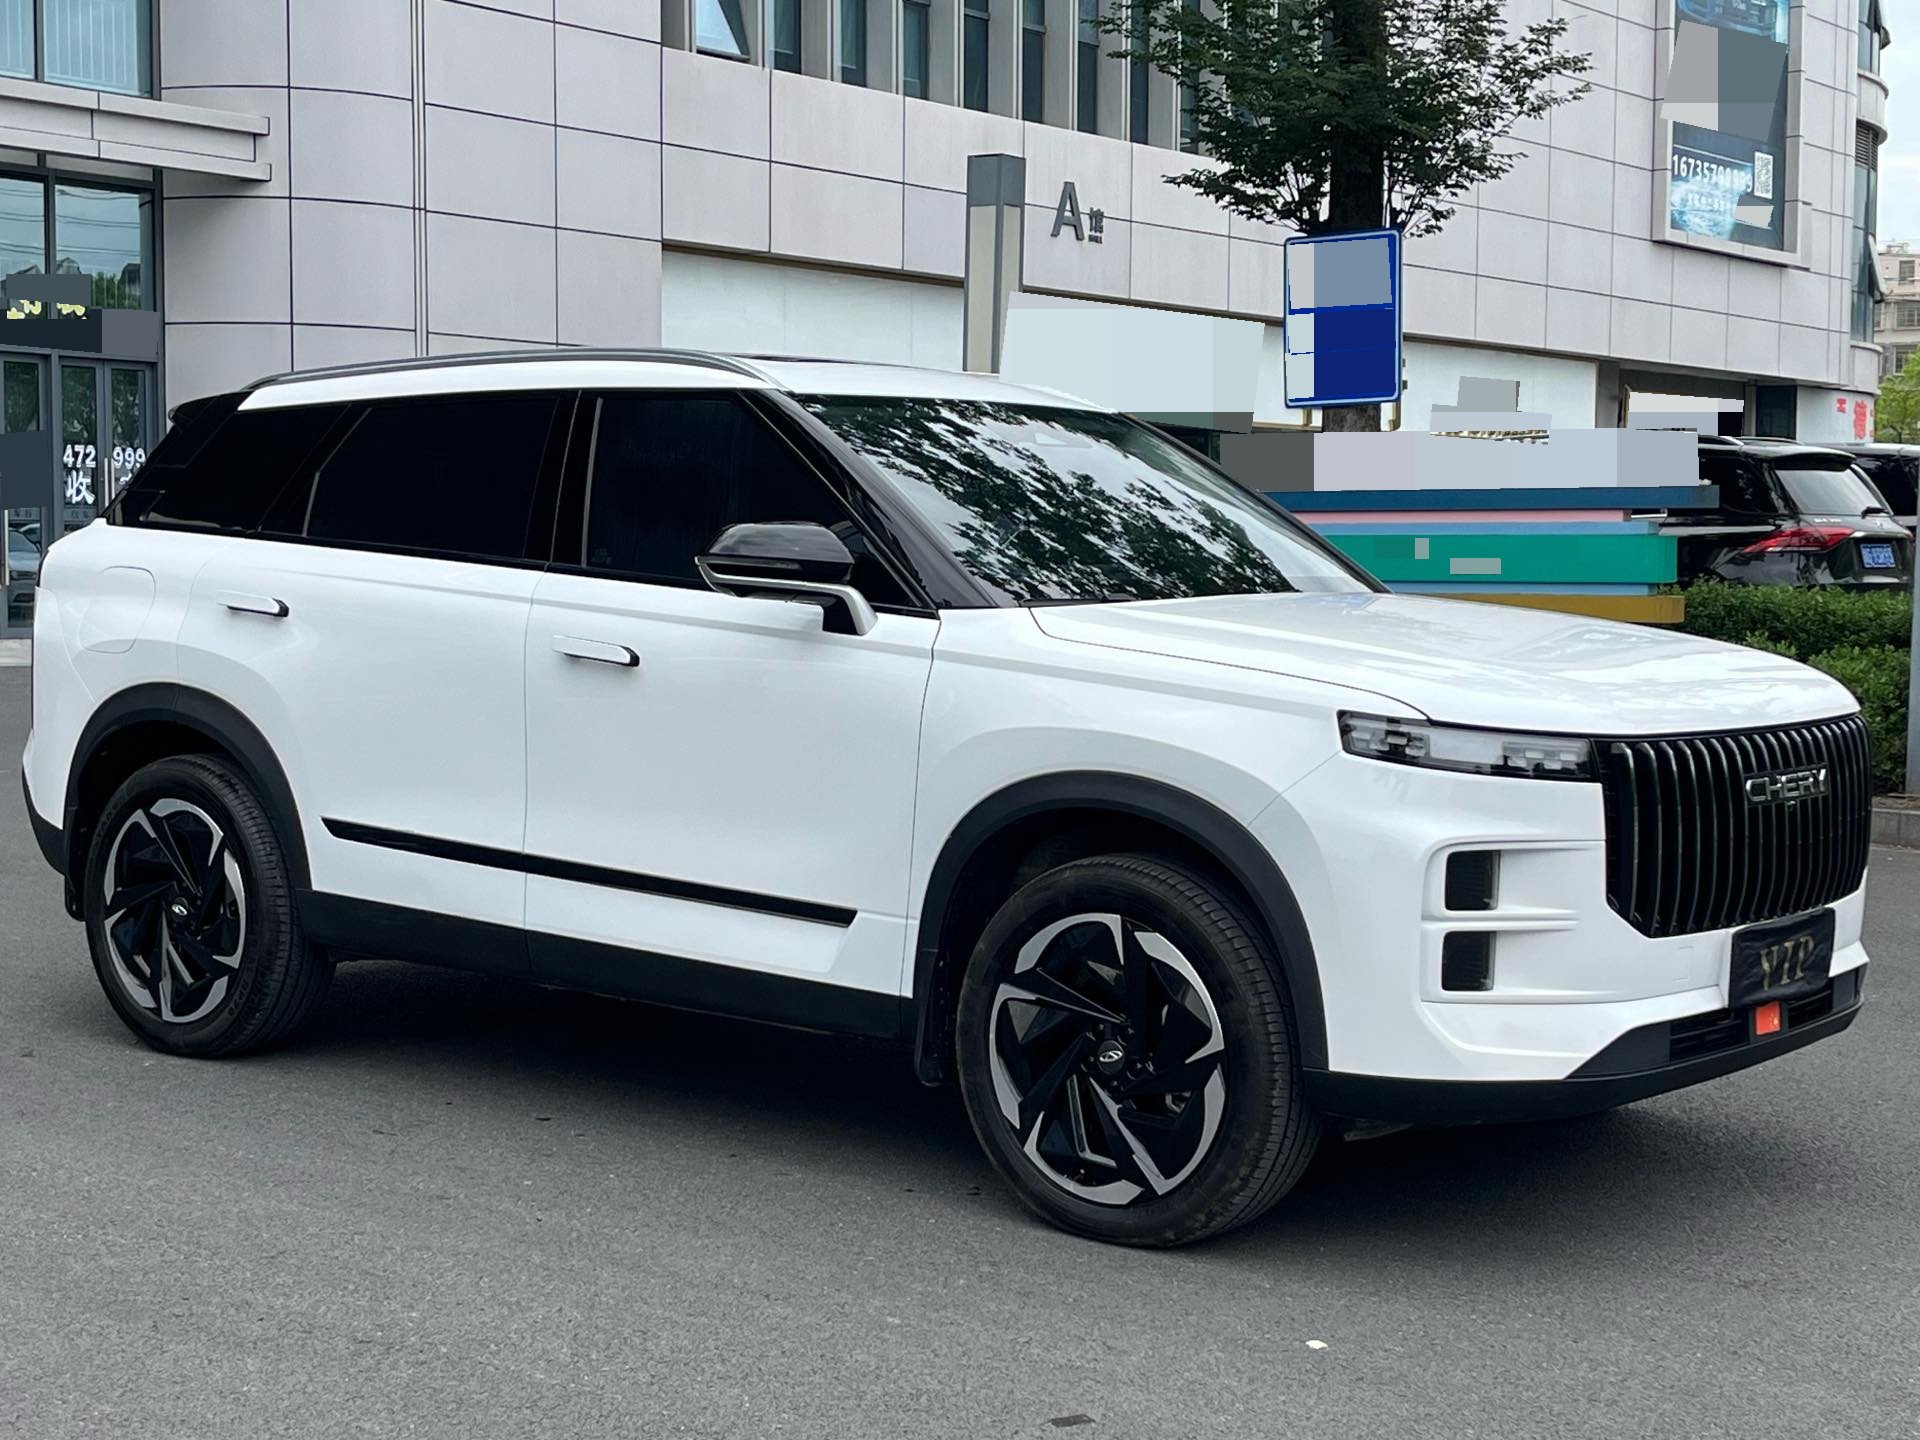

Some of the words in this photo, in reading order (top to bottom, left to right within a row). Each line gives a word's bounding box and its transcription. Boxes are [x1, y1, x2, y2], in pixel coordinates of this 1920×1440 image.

[1050, 181, 1085, 241] A
[63, 444, 96, 468] 472
[65, 470, 96, 505] 收
[1745, 768, 1828, 802] CHERY
[1760, 935, 1814, 991] VIP
